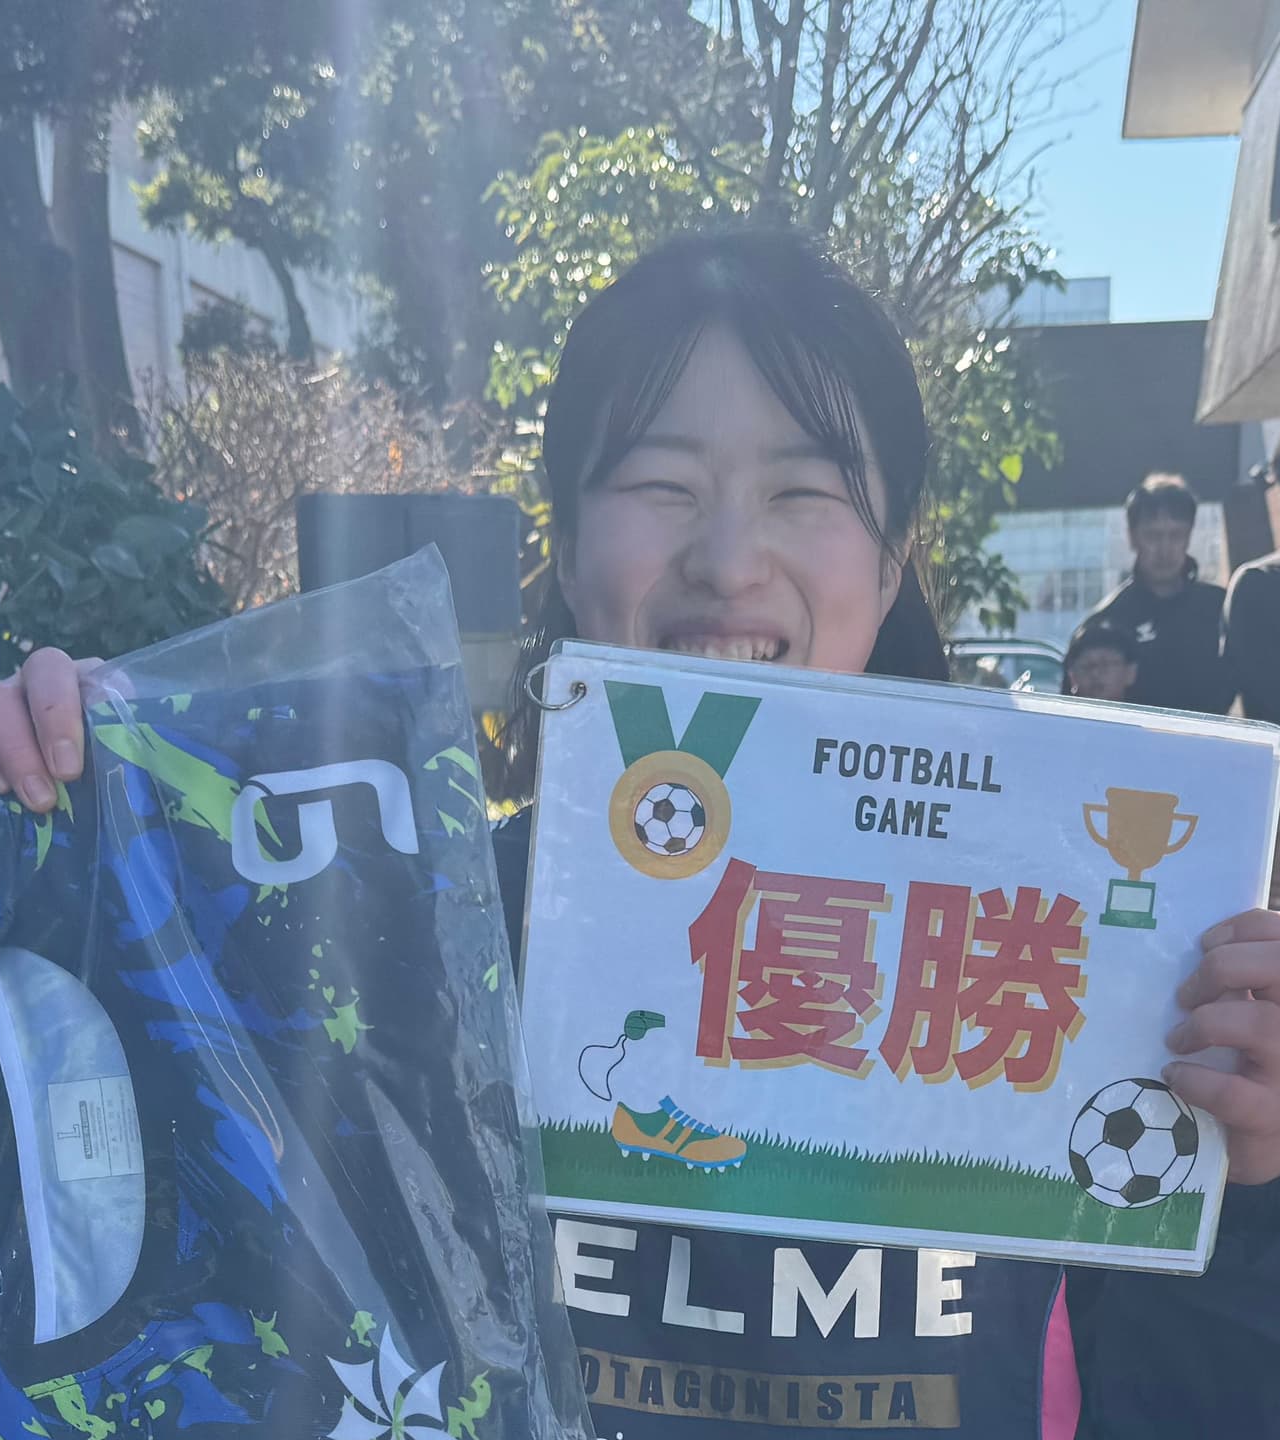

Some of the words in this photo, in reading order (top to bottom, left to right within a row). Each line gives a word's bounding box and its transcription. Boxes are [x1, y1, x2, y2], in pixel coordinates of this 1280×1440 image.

[812, 737, 1002, 794] FOOTBALL
[853, 795, 951, 840] GAME
[688, 857, 1087, 1092] 優勝
[553, 1218, 977, 1339] ELME
